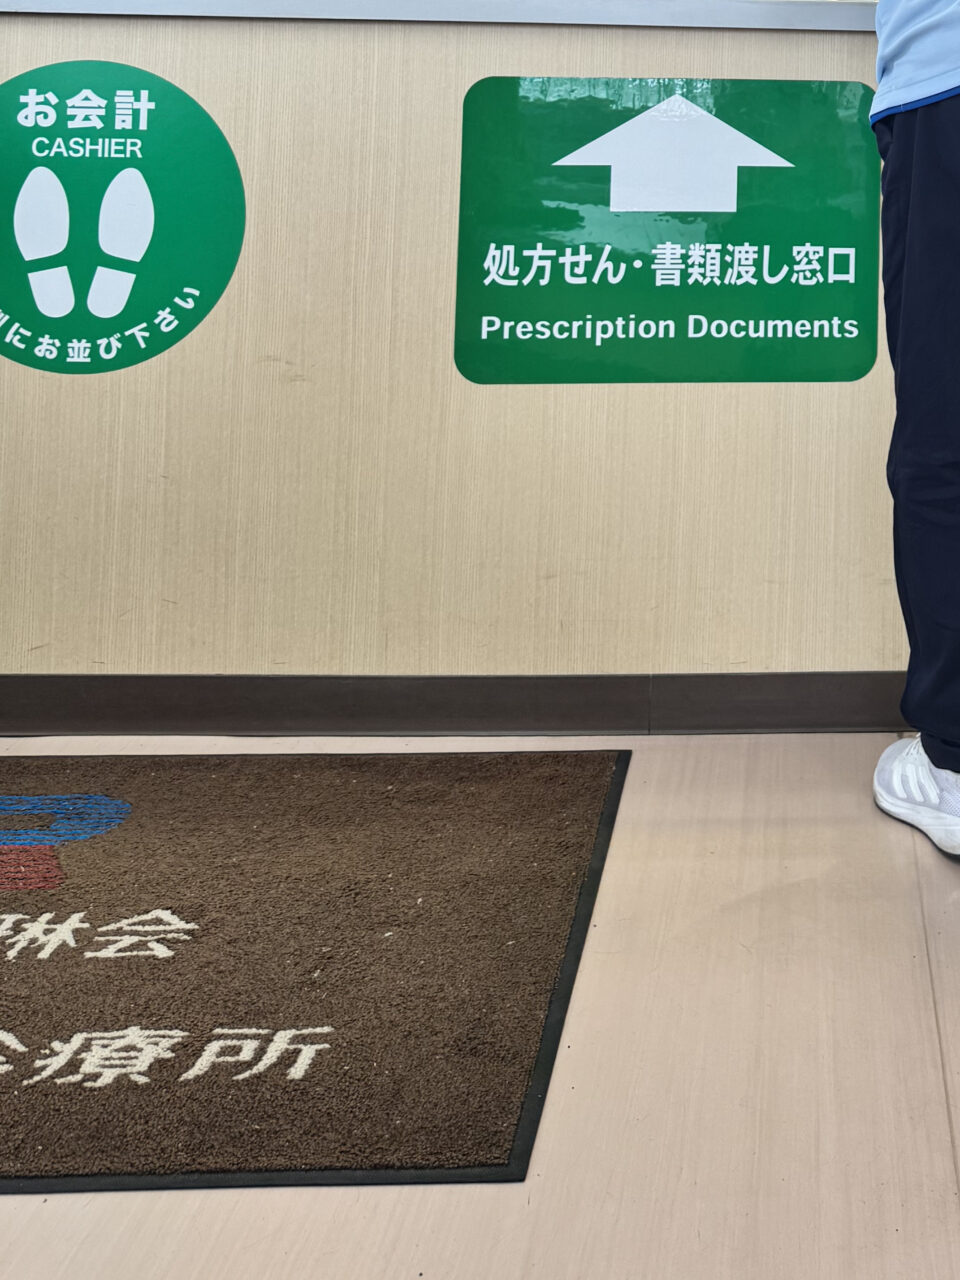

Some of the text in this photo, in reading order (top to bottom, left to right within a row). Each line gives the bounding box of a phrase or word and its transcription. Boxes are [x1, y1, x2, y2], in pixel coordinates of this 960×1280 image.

[16, 88, 156, 131] お会計
[31, 136, 143, 159] CASHIER
[482, 241, 857, 287] 処方せん・書類渡し窓口
[481, 314, 860, 346] Prescription Documents
